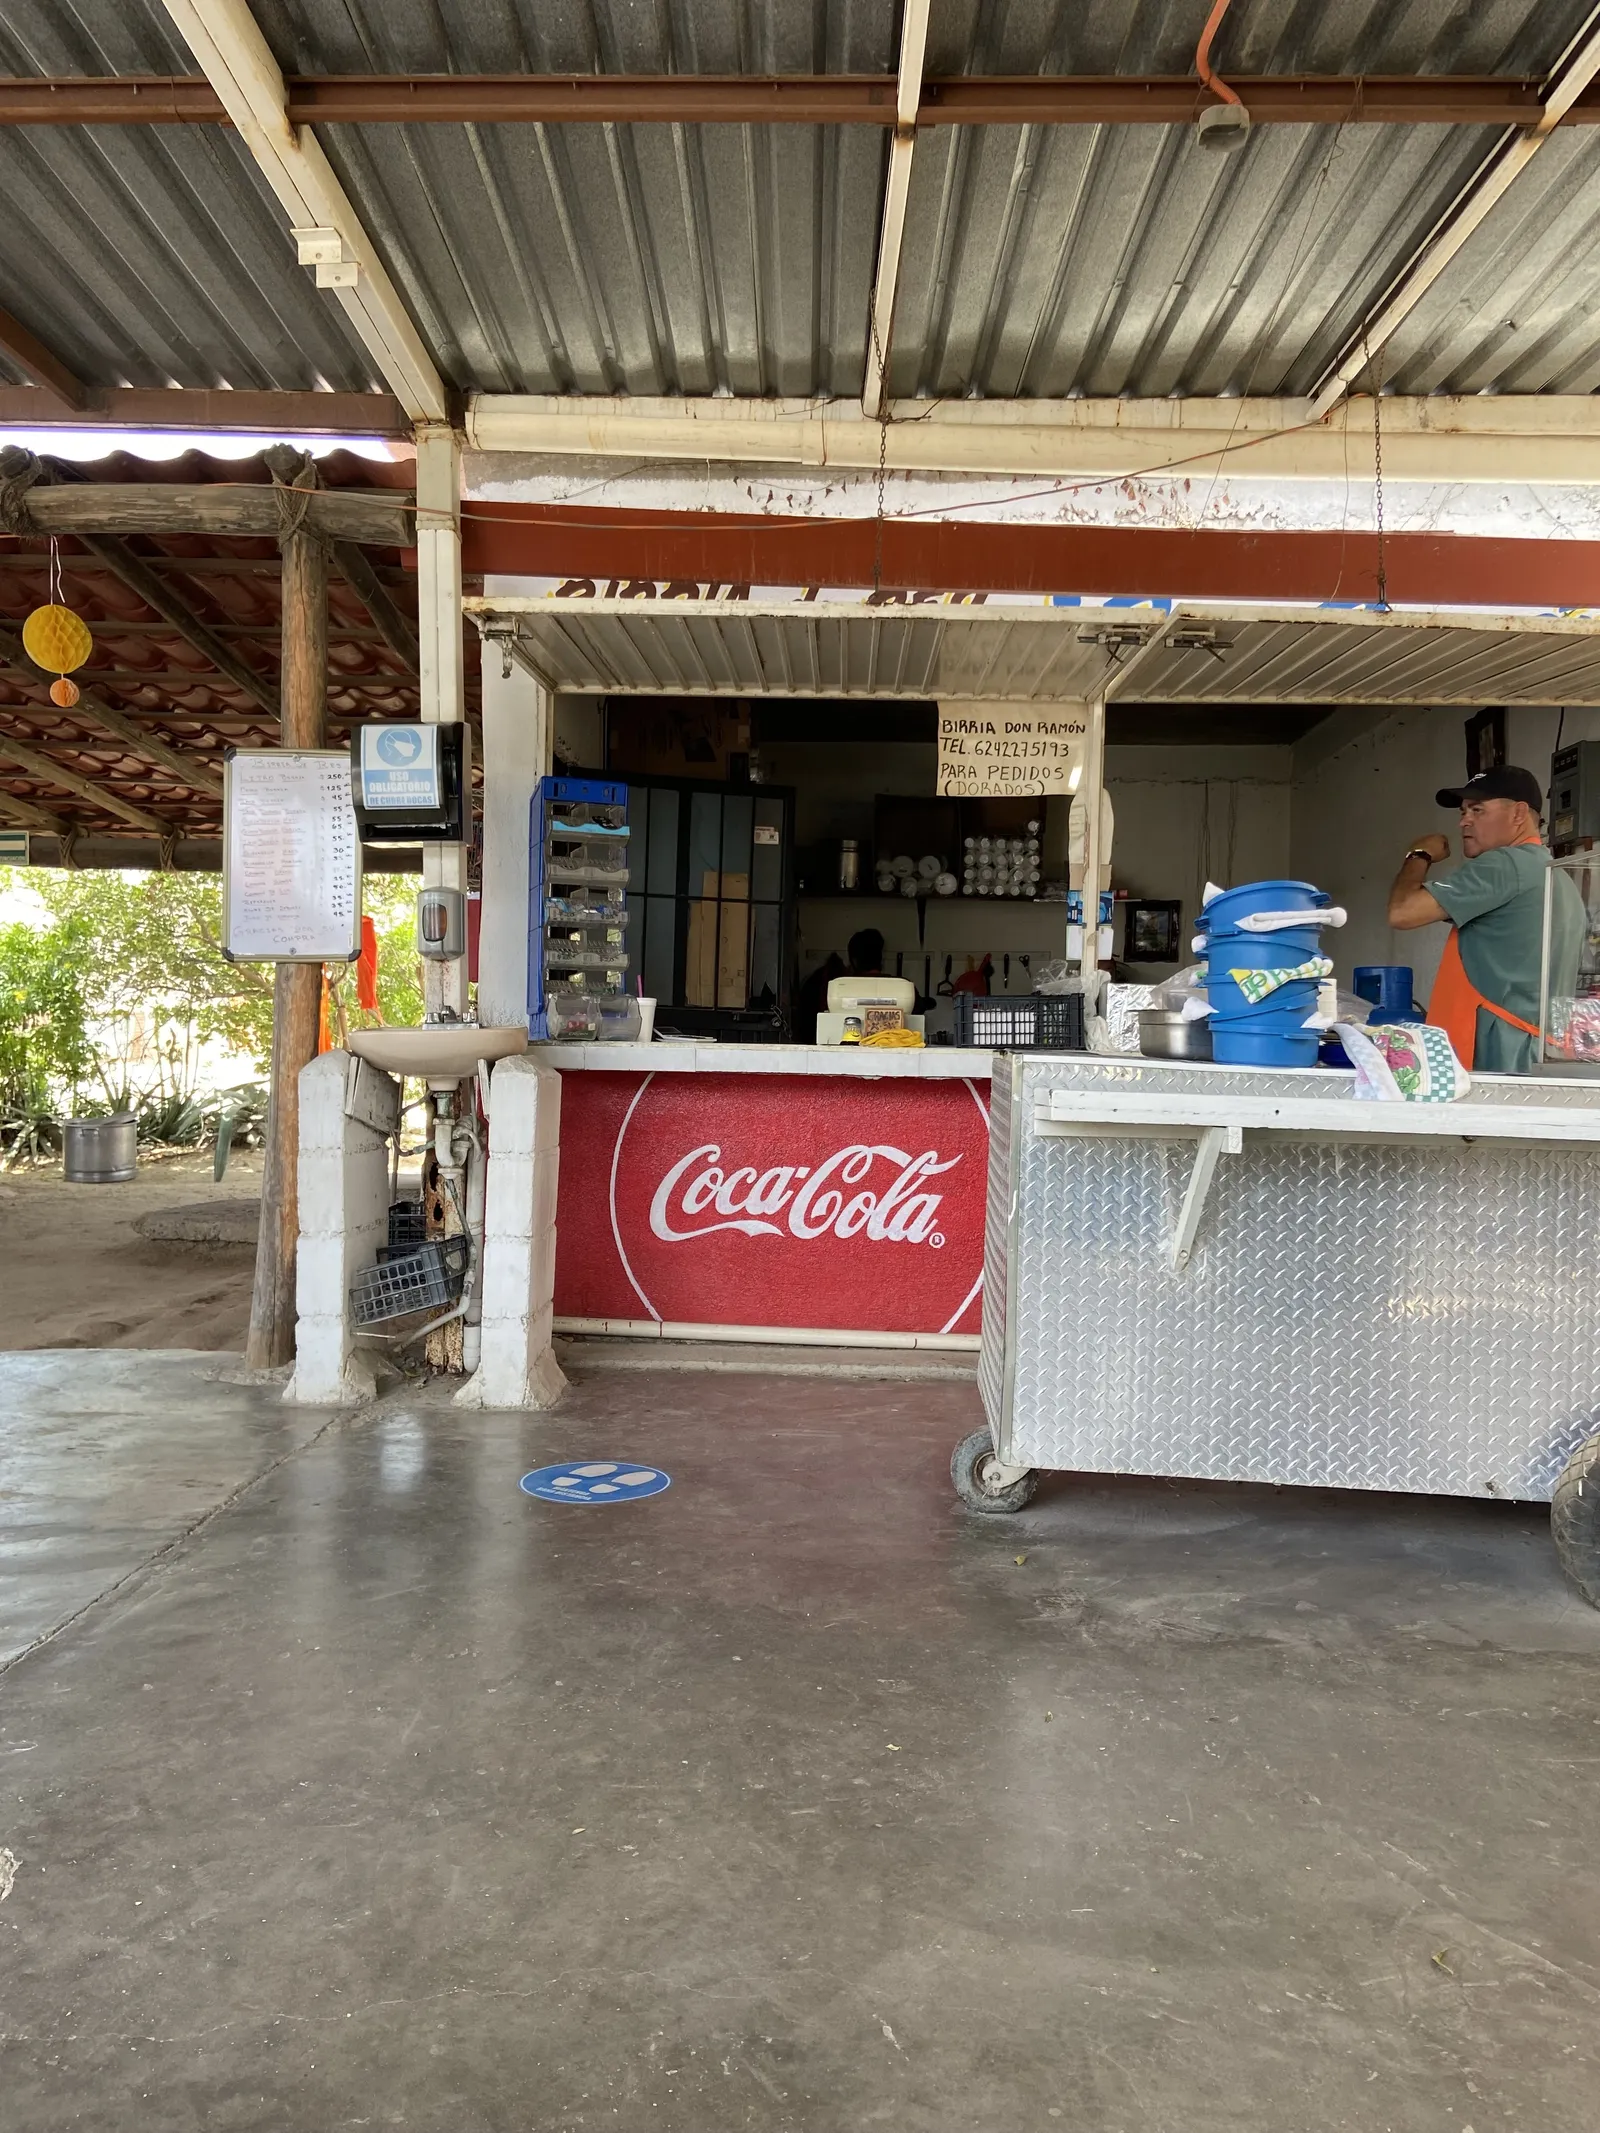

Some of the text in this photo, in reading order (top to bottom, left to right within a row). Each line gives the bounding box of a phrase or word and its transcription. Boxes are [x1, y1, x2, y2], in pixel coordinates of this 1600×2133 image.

[941, 719, 1086, 735] BIRRIA DON RAMÓN
[939, 736, 1070, 758] TEL. 6242275193
[389, 771, 409, 781] USO
[940, 762, 1065, 781] PARA PEDIDOS
[369, 781, 431, 793] OBLIGATORIO
[944, 780, 1046, 797] (DORADOS)
[649, 1143, 965, 1243] Coca-Cola
